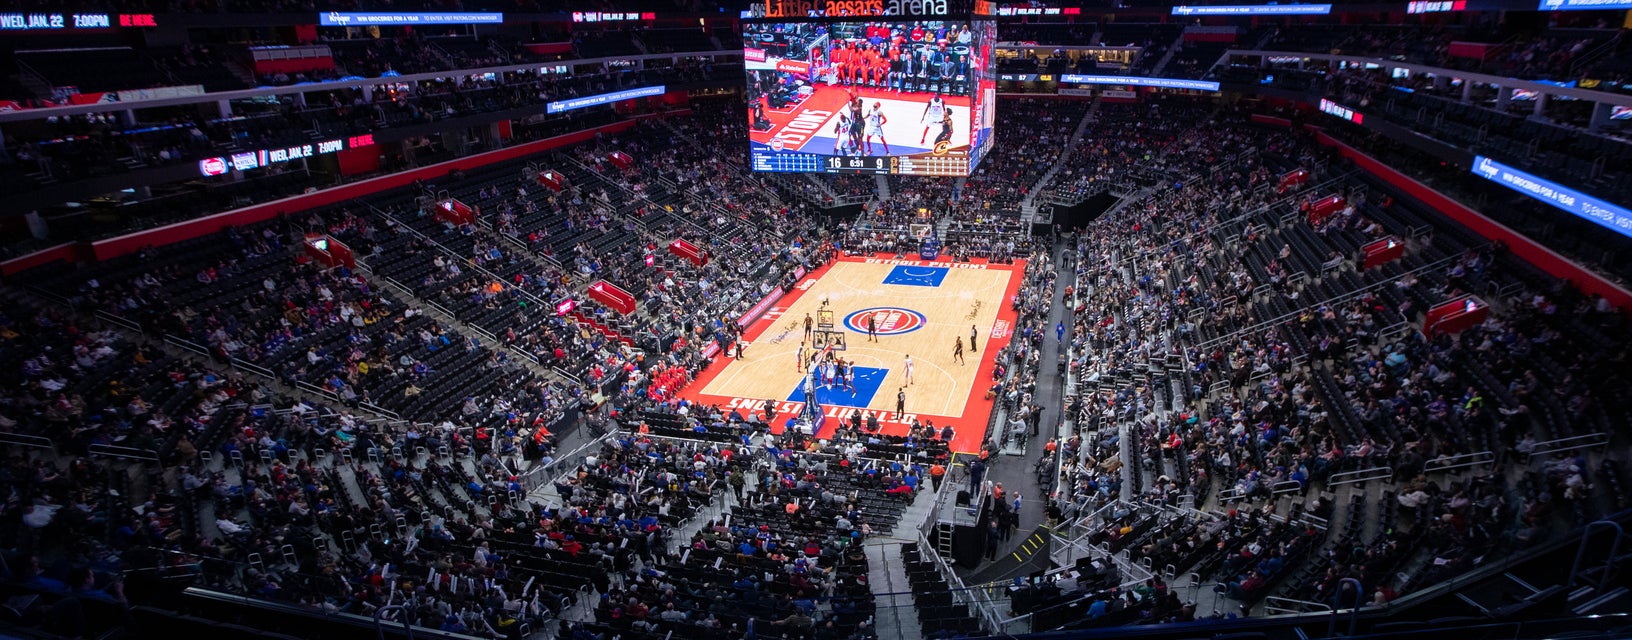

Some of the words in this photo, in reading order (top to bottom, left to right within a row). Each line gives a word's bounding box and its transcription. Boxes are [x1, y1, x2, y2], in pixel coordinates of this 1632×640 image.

[888, 0, 947, 15] arena
[50, 14, 64, 28] 22
[73, 14, 110, 28] 7:00PM
[768, 108, 832, 150] ISTONS
[270, 150, 288, 162] WED,
[288, 147, 303, 160] JAN.
[318, 140, 342, 154] 7:00PM
[828, 157, 841, 168] 16
[876, 158, 883, 169] 9
[866, 258, 922, 266] DETROIT
[929, 261, 988, 269] PISTONS
[726, 398, 802, 414] ISTONS
[825, 407, 917, 425] DETRIT
